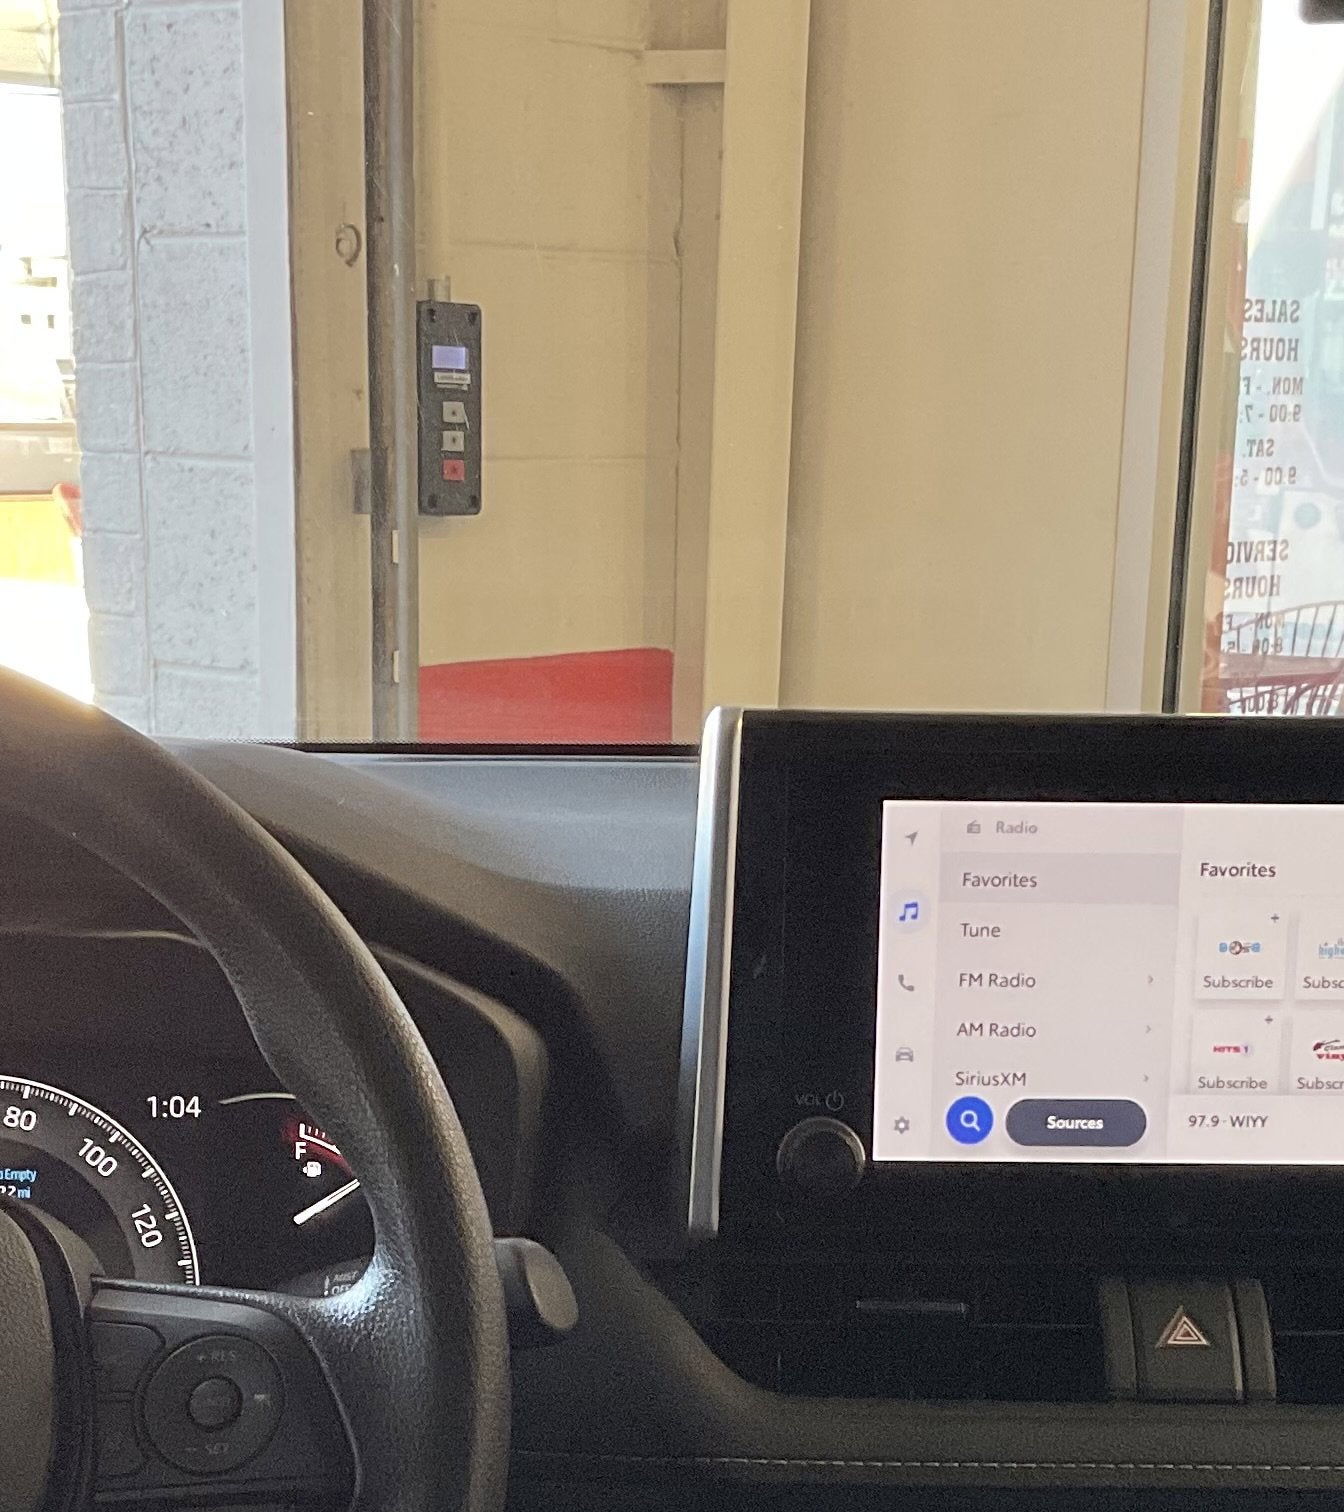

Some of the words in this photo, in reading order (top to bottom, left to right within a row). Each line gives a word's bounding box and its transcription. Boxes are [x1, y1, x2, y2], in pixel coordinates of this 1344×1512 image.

[995, 820, 1039, 836] Radio
[1199, 861, 1277, 880] Favorites
[962, 871, 1038, 889] Favorites
[960, 921, 1002, 939] Tune
[959, 973, 984, 989] FM
[989, 971, 1037, 989] Radio
[1203, 975, 1274, 989] Subscribe
[956, 1023, 985, 1039] AM
[988, 1021, 1037, 1039] Radio
[955, 1071, 1027, 1087] SiriusXM
[1197, 1076, 1268, 1090] Subscribe
[146, 1096, 202, 1119] 1:04
[3, 1105, 37, 1132] 80
[1046, 1115, 1104, 1131] Sources
[1188, 1115, 1220, 1128] 97.9
[1229, 1115, 1269, 1128] WIYY
[77, 1137, 118, 1178] 100
[295, 1141, 307, 1160] F
[4, 1168, 37, 1183] Empty
[17, 1187, 31, 1198] mi
[131, 1203, 163, 1249] 120
